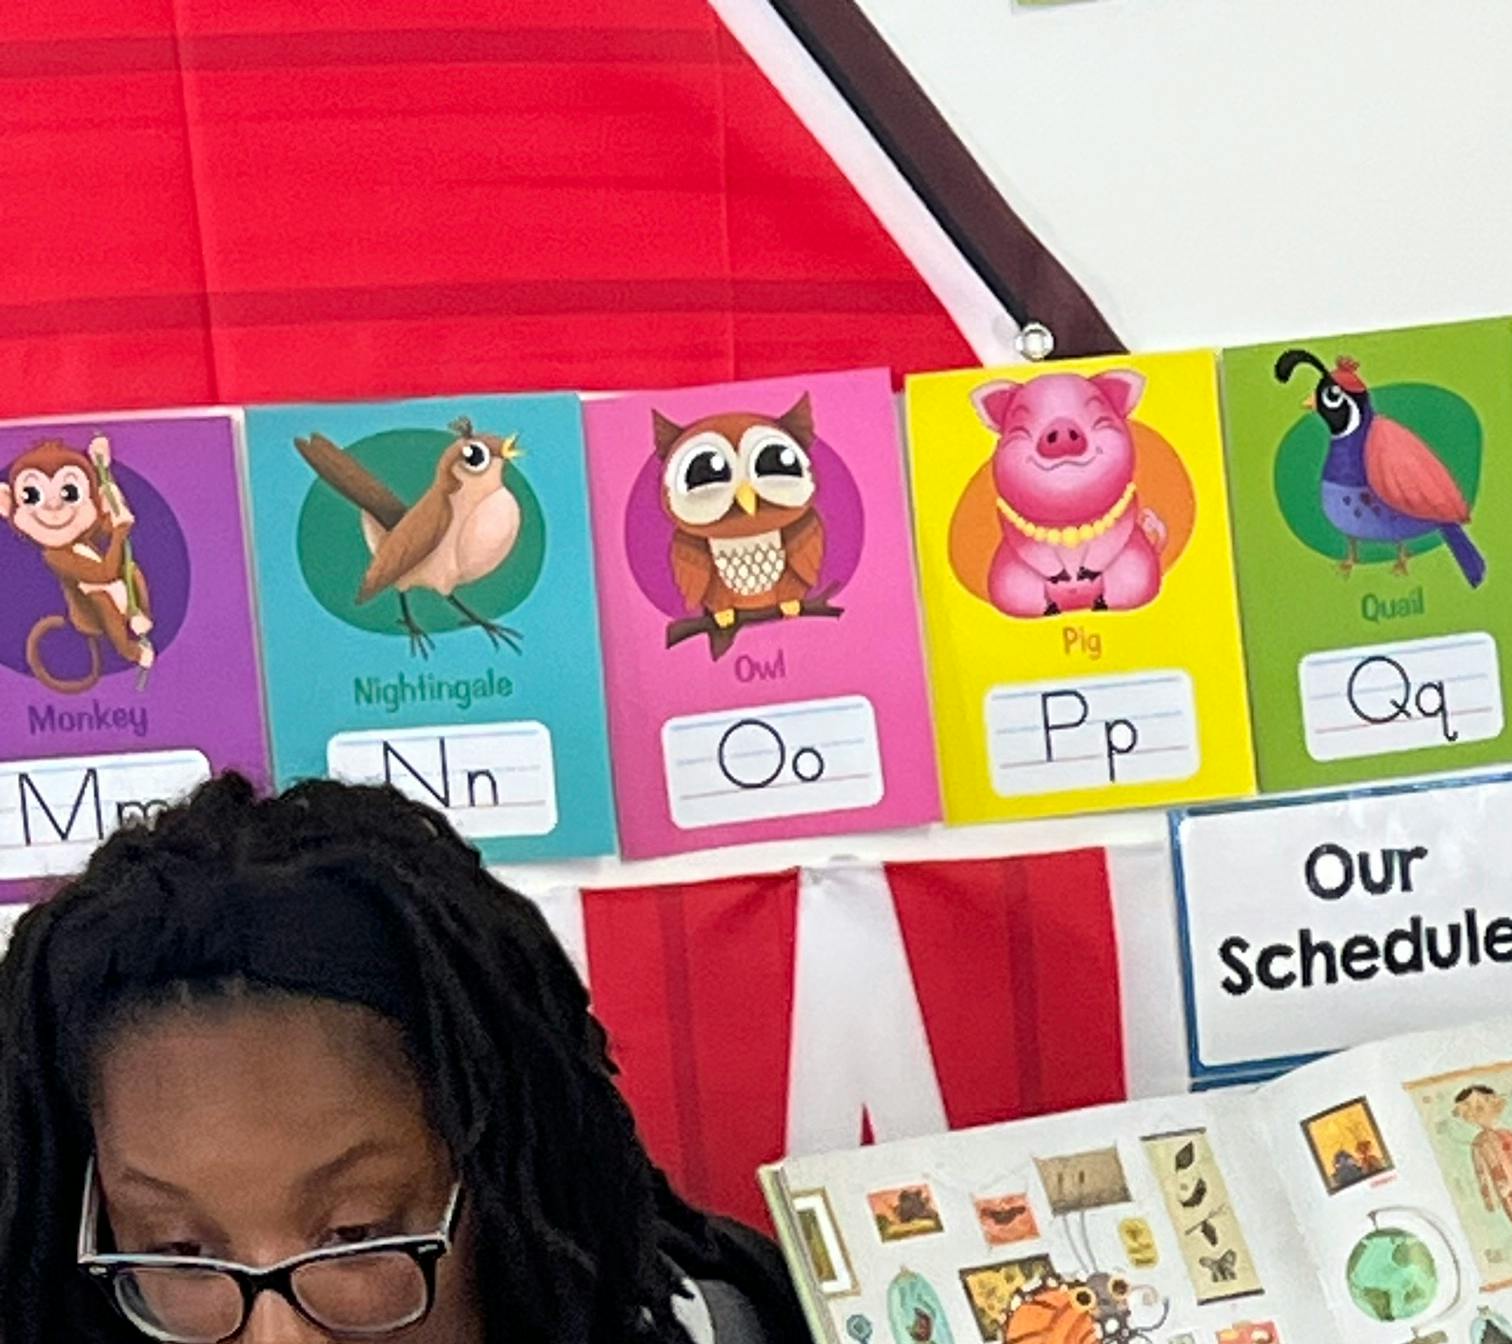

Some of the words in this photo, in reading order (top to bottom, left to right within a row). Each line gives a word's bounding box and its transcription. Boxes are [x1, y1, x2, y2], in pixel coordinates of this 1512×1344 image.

[1361, 588, 1425, 623] Quail
[734, 651, 786, 682] Owl
[1062, 626, 1101, 660] Pig
[352, 668, 513, 713] Nightingale
[1347, 655, 1458, 742] Qq
[28, 701, 148, 737] Monkey
[1041, 689, 1138, 783] Pp
[383, 737, 499, 807] Nn
[718, 718, 824, 789] Oo
[1304, 842, 1427, 901] Our
